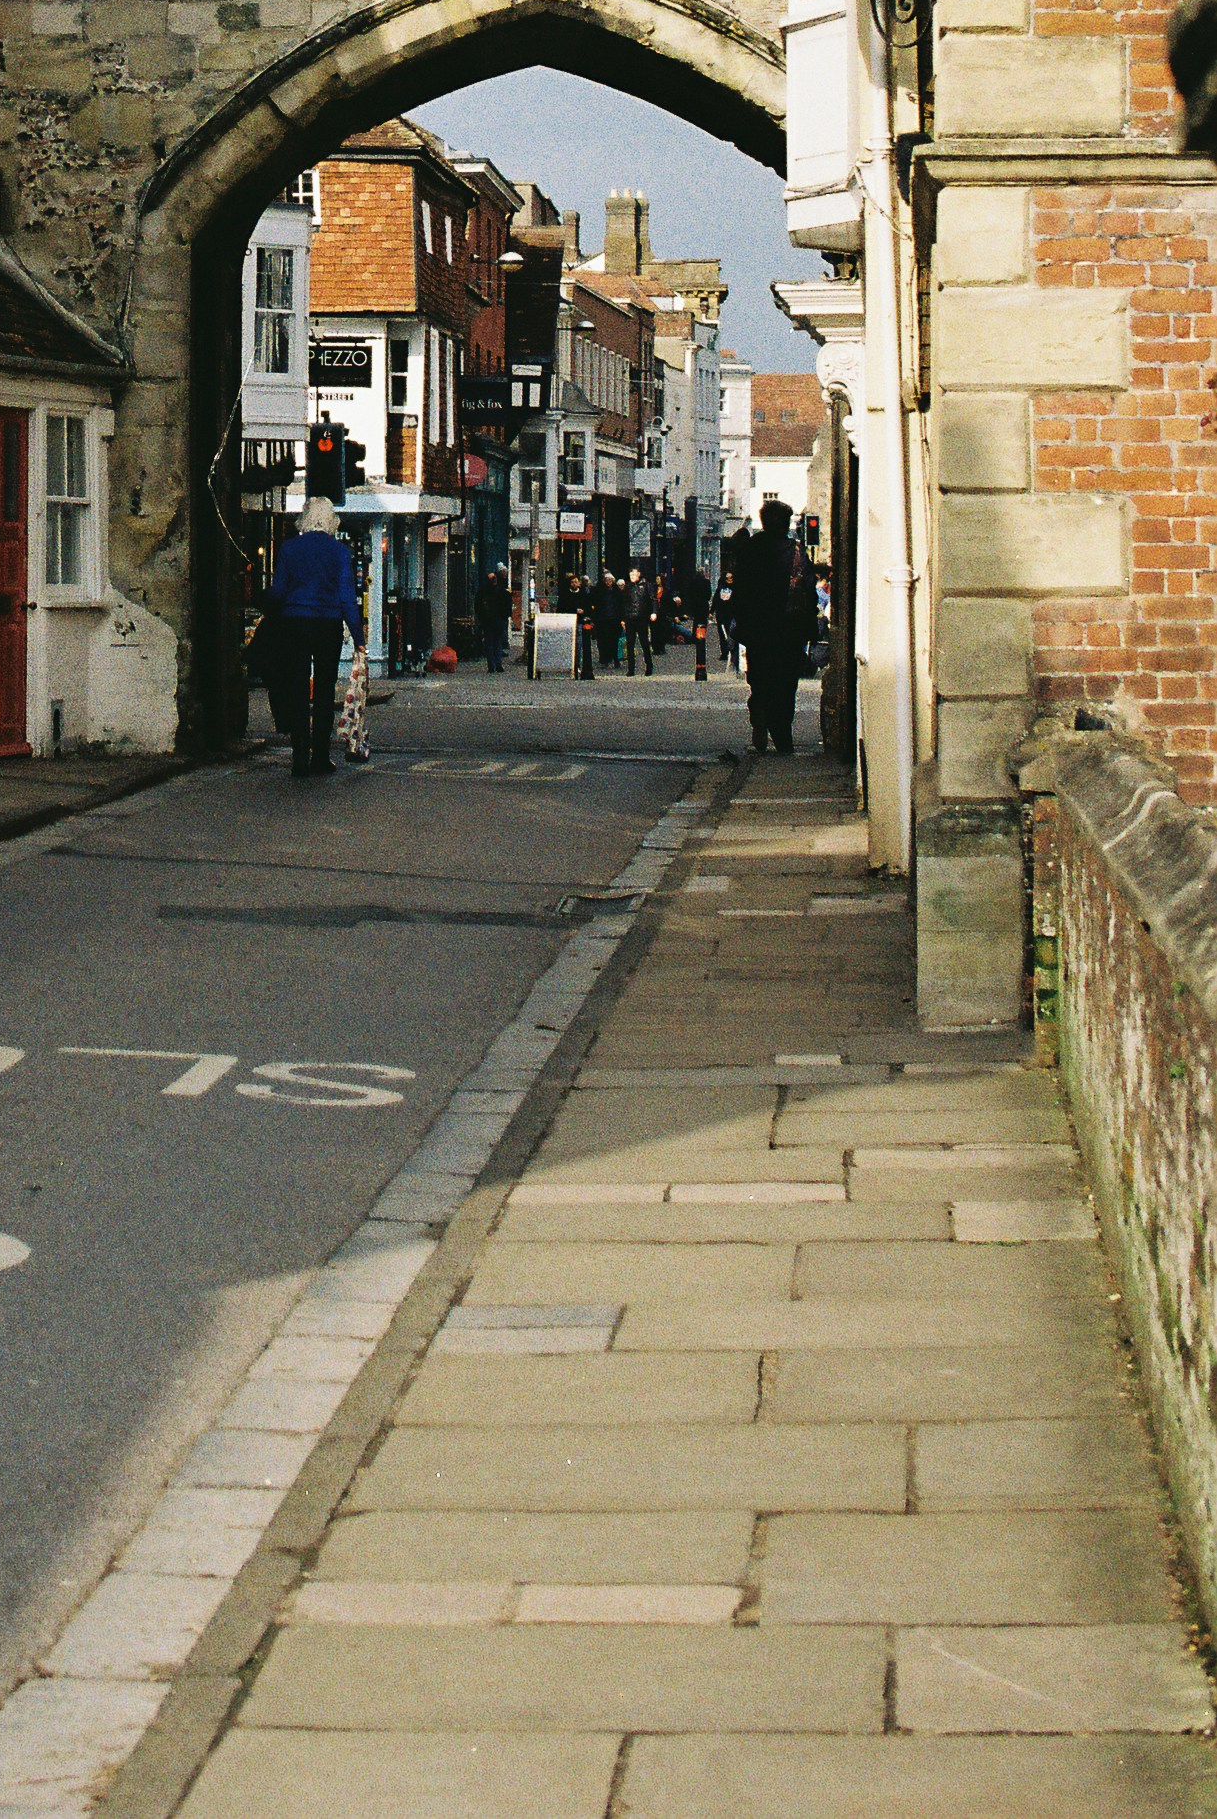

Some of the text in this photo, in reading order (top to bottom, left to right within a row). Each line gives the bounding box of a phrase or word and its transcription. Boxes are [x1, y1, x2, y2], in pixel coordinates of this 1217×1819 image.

[462, 398, 503, 410] fig & fox
